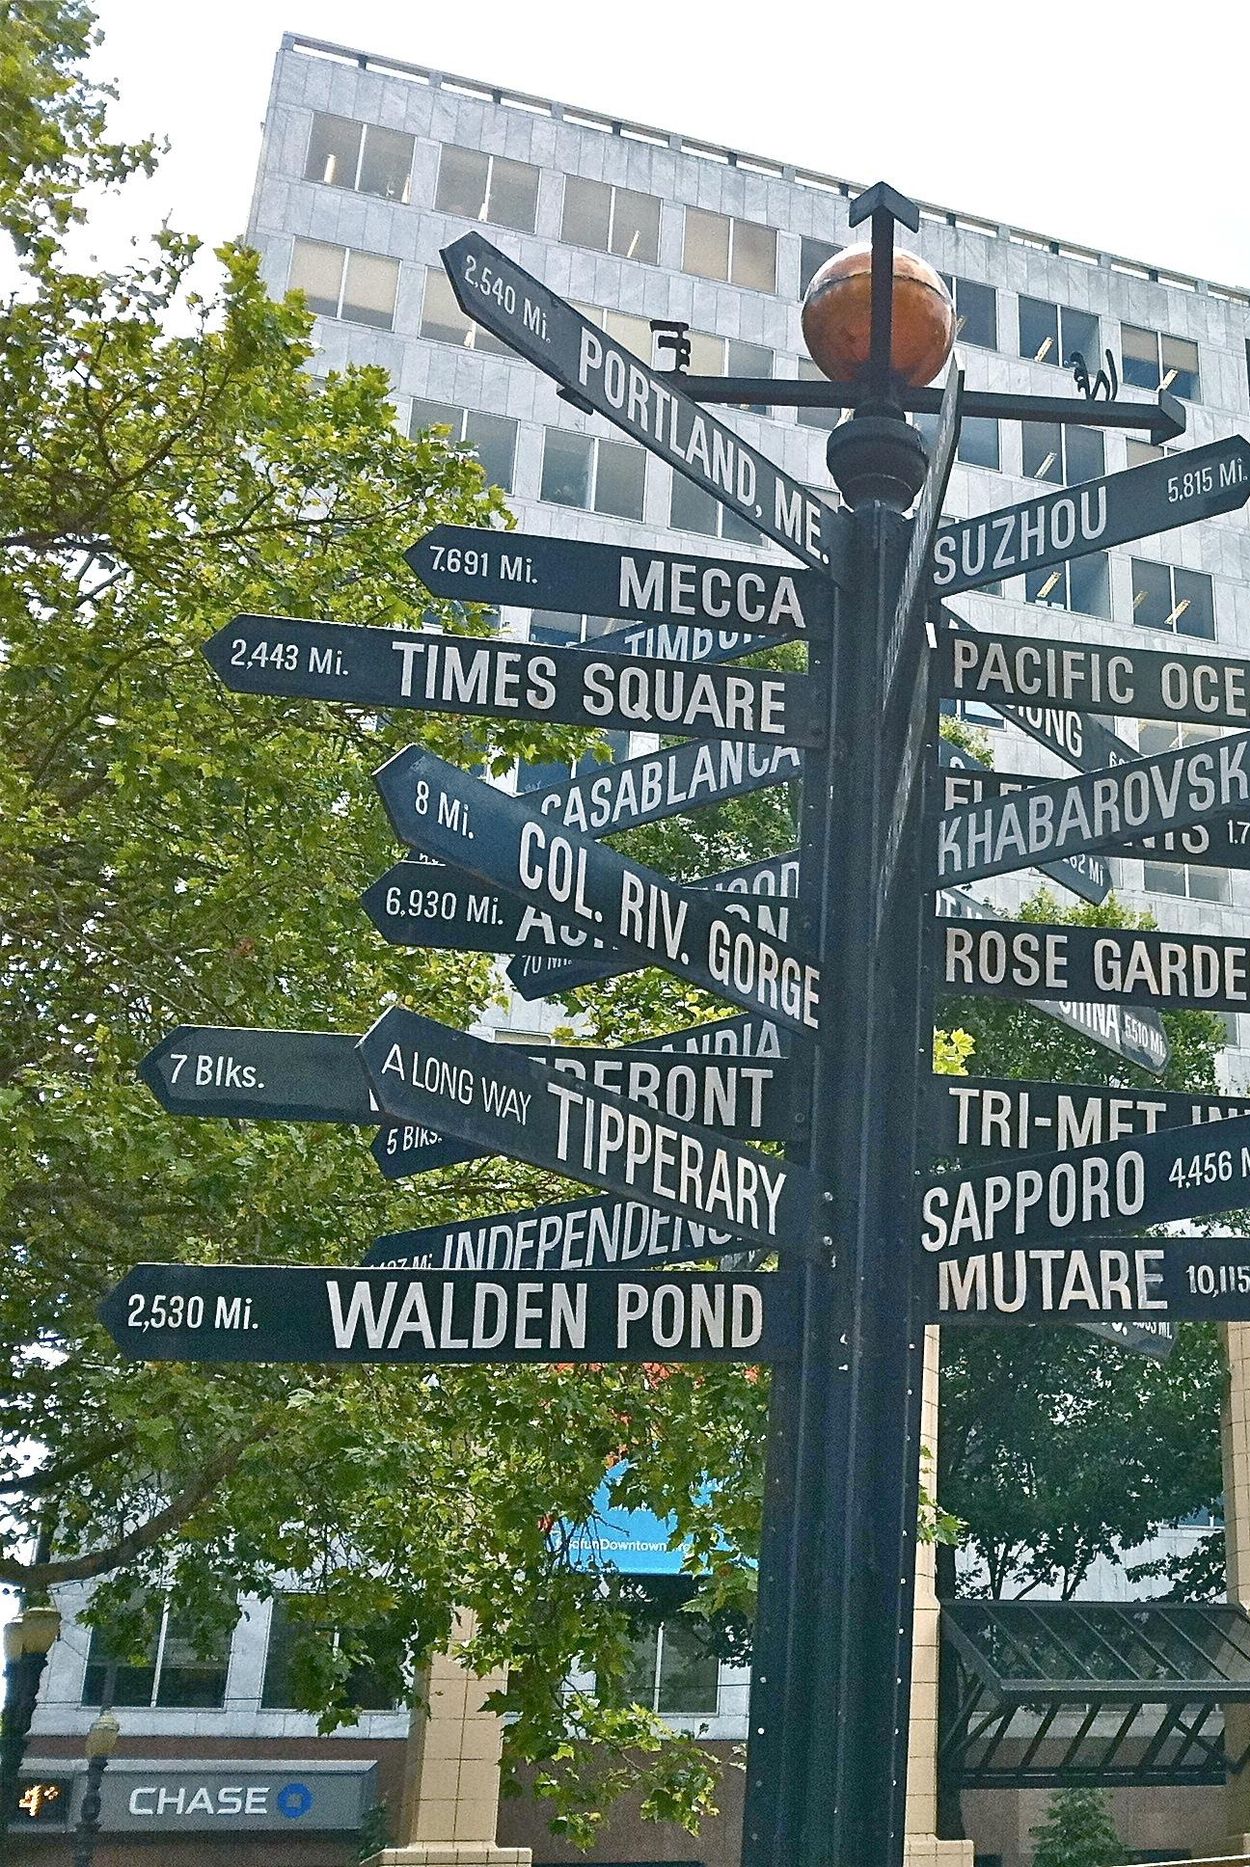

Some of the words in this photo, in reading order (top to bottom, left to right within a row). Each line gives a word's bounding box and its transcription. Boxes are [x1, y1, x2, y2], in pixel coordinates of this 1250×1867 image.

[464, 255, 516, 315] 2,540
[523, 296, 552, 344] Mi.
[579, 326, 763, 518] PORTLAND,
[774, 478, 830, 565] ME.
[933, 487, 1108, 585] SUZHOU
[1167, 467, 1213, 503] 5,815
[1219, 458, 1248, 487] Mi.
[500, 554, 538, 584] Mi.
[618, 558, 806, 628] MECCA
[230, 639, 299, 671] 2,443
[308, 647, 349, 675] Mi.
[392, 643, 556, 709] TIMES
[582, 663, 785, 734] SQUARE
[953, 639, 1135, 705] PACIFIC
[938, 741, 1249, 876] KHABAROVSK
[1227, 819, 1250, 845] 1.7
[386, 886, 457, 920] 6,930
[466, 894, 503, 925] Mi.
[415, 780, 429, 815] 8
[437, 792, 474, 839] Mi.
[519, 820, 602, 923] COL.
[620, 870, 689, 965] RIV.
[708, 920, 820, 1029] GORGE
[945, 927, 1068, 988] ROSE
[169, 1053, 189, 1085] 7
[195, 1055, 265, 1091] Blks.
[381, 1043, 405, 1080] A
[412, 1051, 474, 1105] LONG
[481, 1076, 532, 1126] WAY
[547, 1082, 787, 1236] TIPPERARY
[386, 1128, 399, 1155] 5
[921, 1150, 1145, 1254] SAPPORO
[1168, 1150, 1232, 1189] 4,456
[127, 1295, 204, 1331] 2,530
[214, 1297, 259, 1331] Mi.
[327, 1280, 585, 1350] WALDEN
[617, 1283, 763, 1349] POND
[938, 1250, 1168, 1312] MUTARE
[129, 1787, 270, 1815] CHASE
